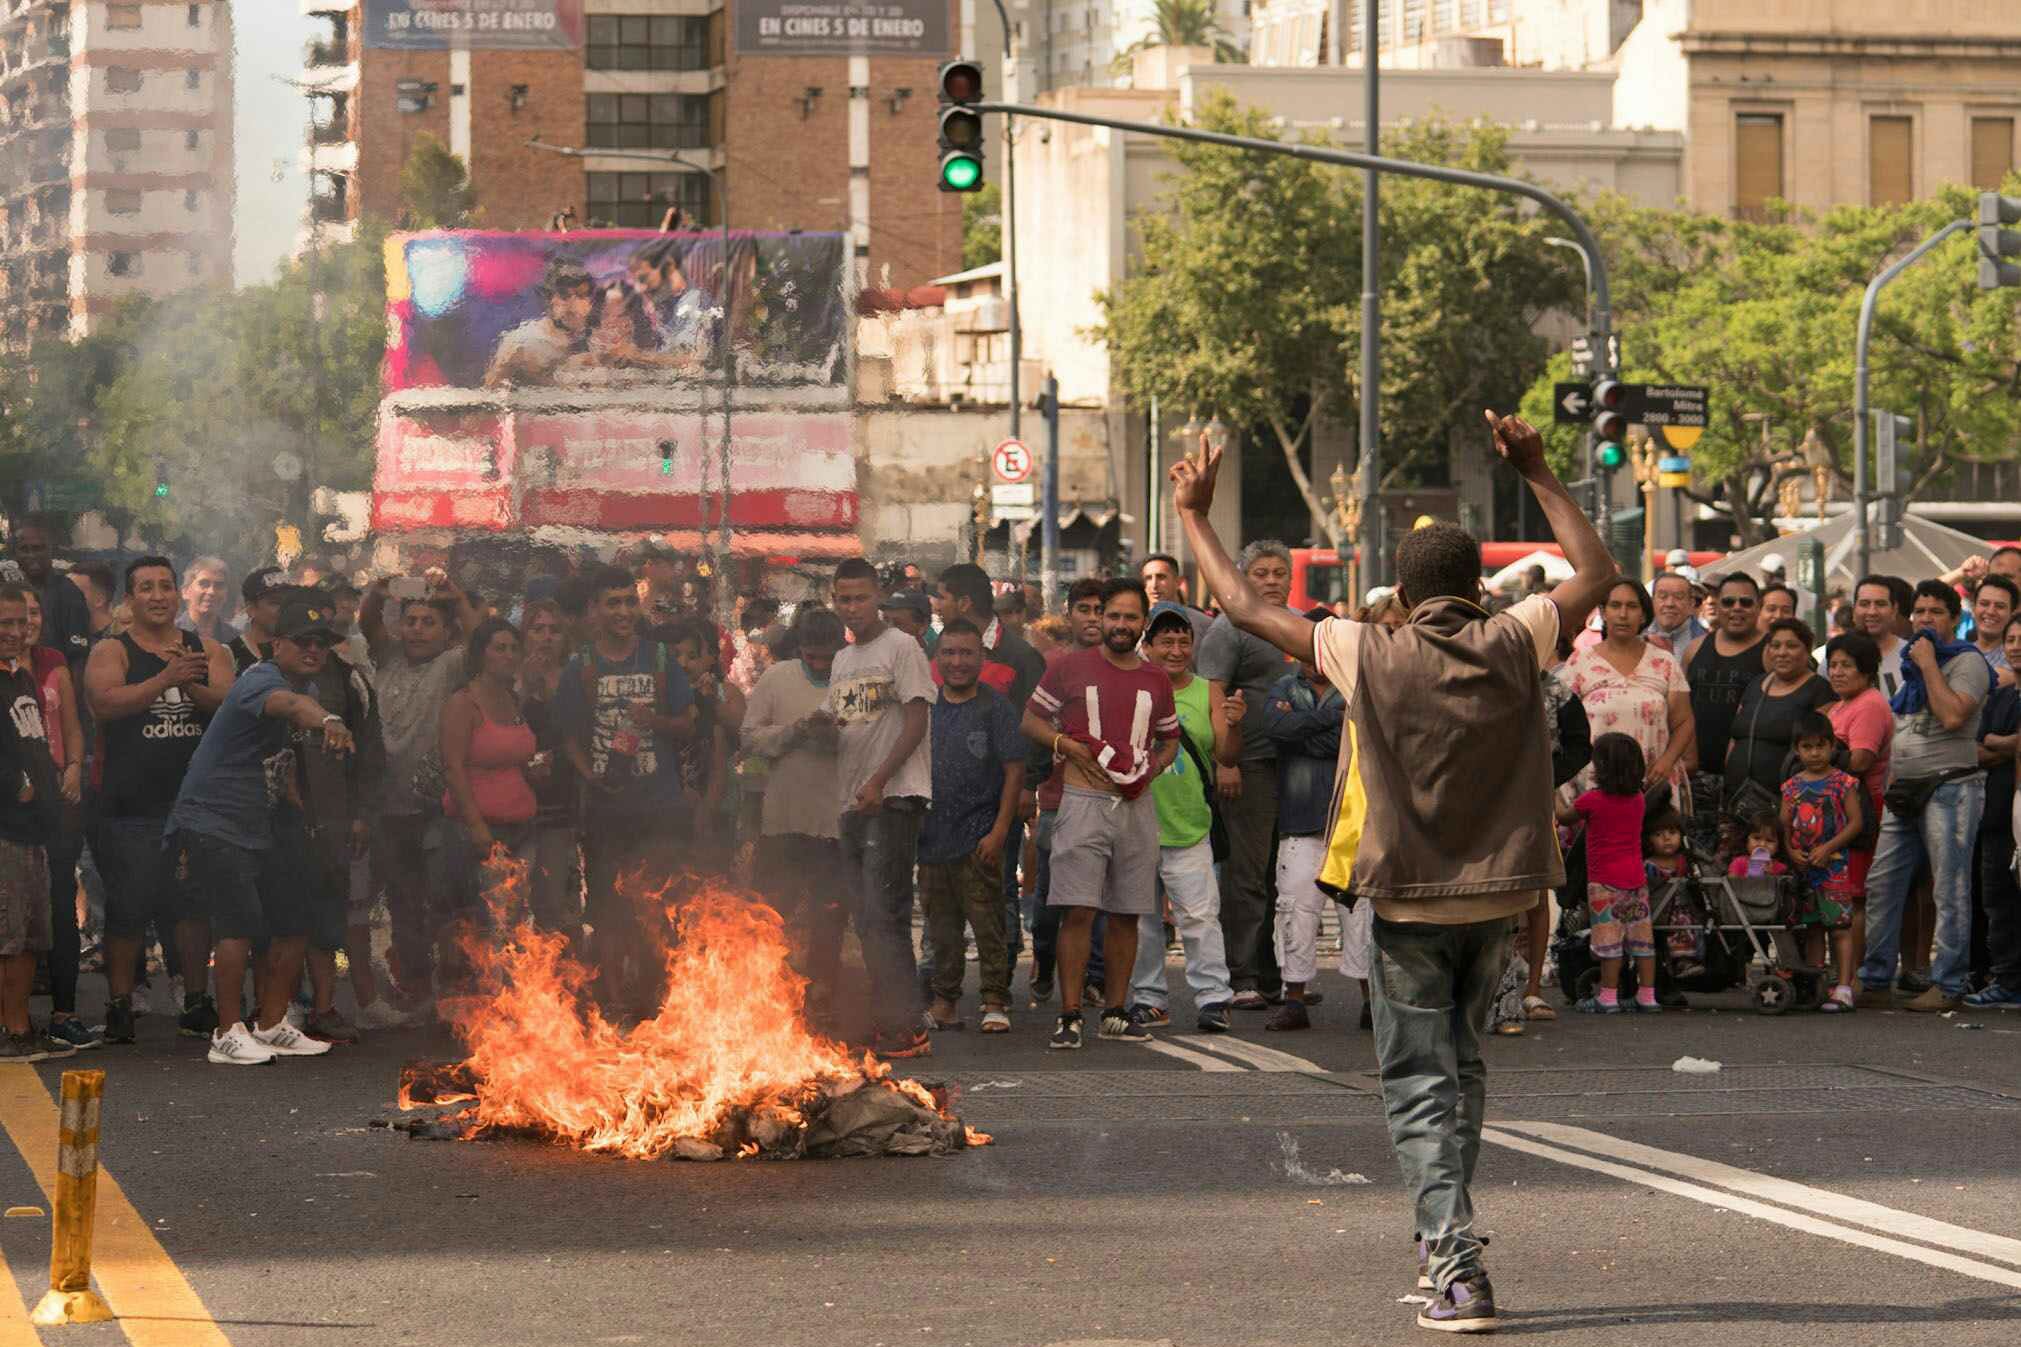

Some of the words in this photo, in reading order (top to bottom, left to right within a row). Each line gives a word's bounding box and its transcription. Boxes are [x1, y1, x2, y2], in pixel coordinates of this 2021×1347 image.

[478, 12, 499, 29] DE
[503, 12, 556, 30] ENERO
[759, 17, 781, 34] EN
[784, 17, 830, 36] CINES
[833, 18, 844, 36] 5
[848, 18, 869, 36] DE
[873, 18, 925, 37] ENERO
[1006, 452, 1019, 471] E
[143, 720, 202, 737] adidas
